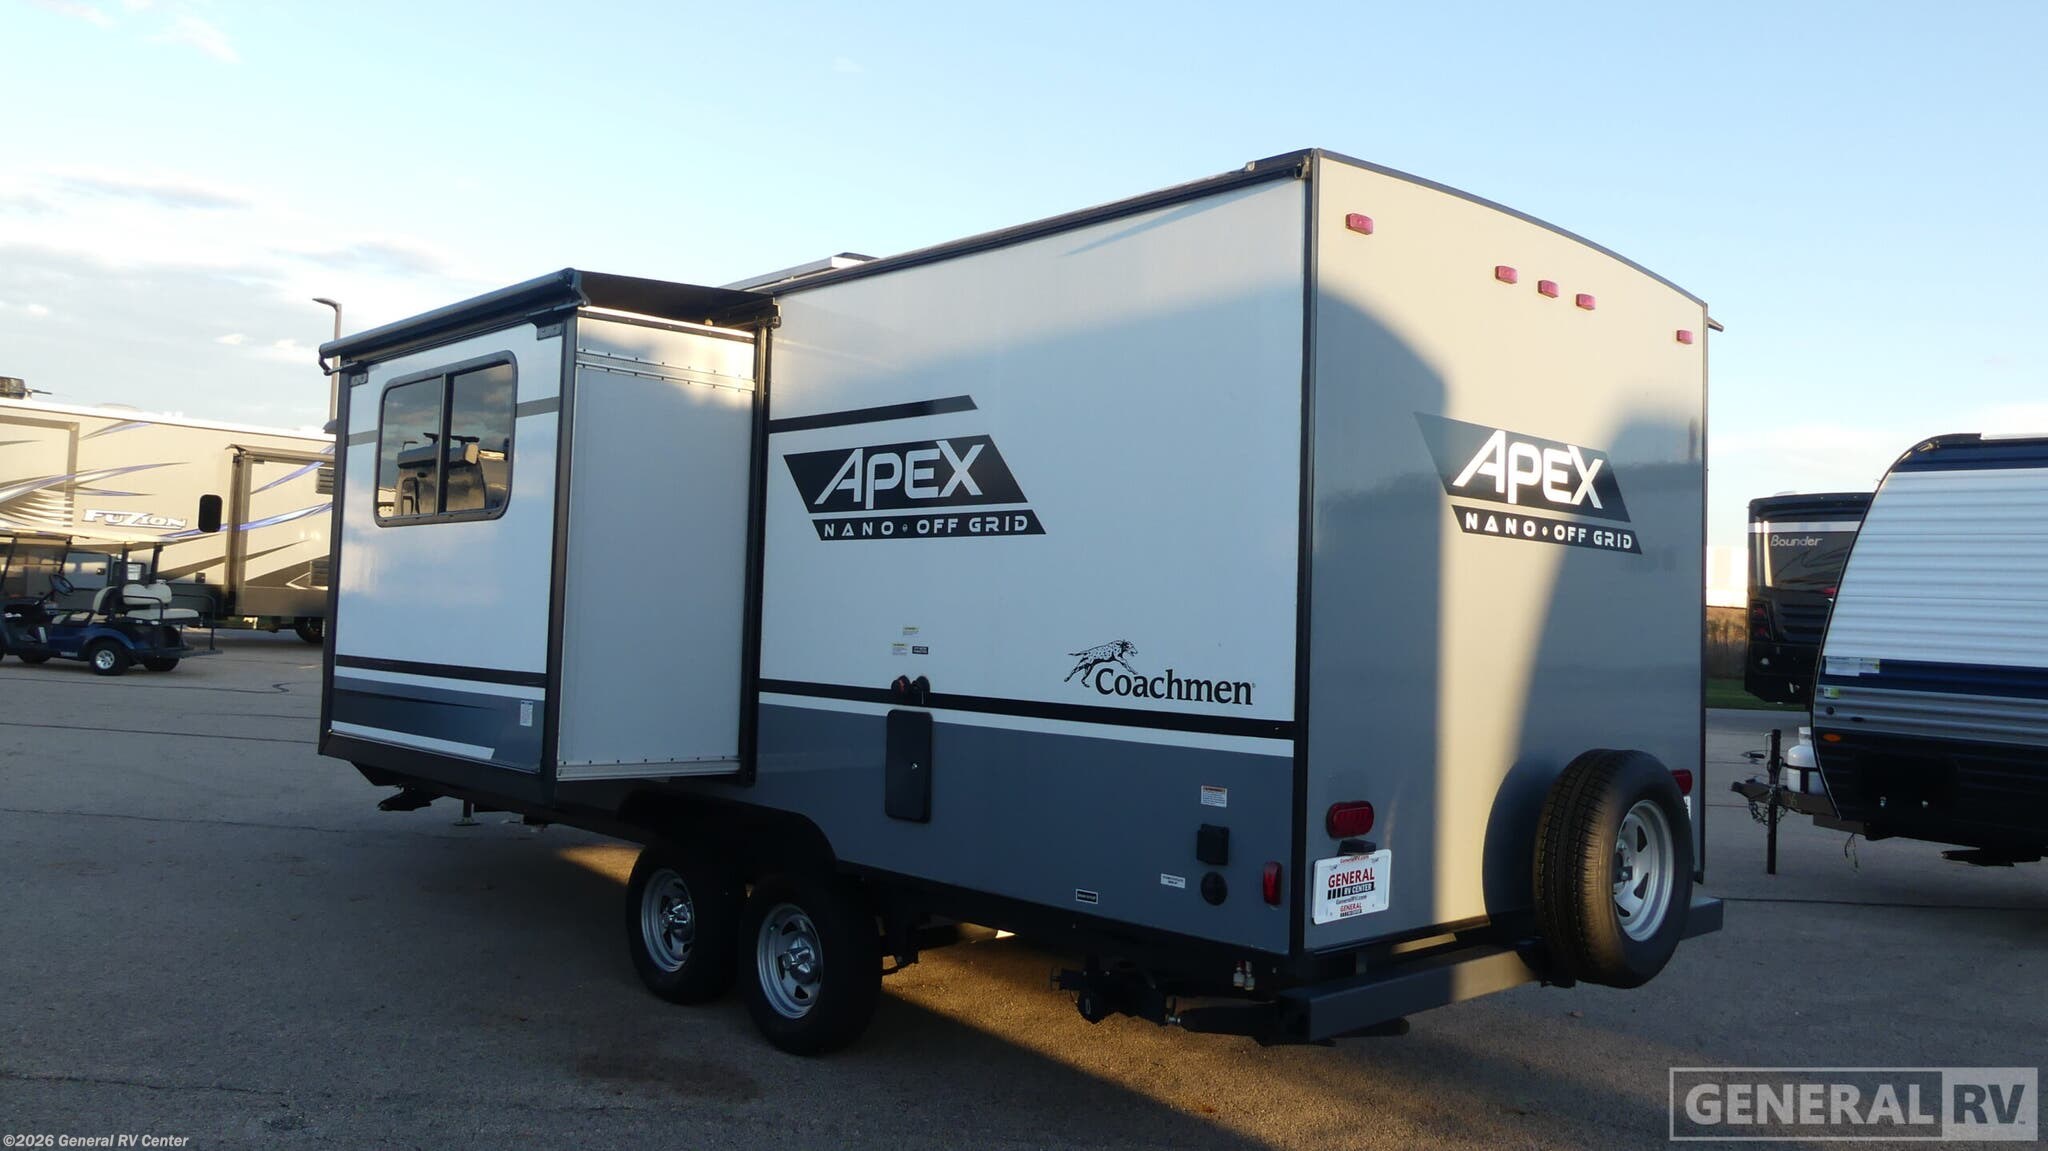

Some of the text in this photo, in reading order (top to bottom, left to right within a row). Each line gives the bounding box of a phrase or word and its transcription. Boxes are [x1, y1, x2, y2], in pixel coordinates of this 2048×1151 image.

[814, 440, 985, 510] APEX
[1452, 429, 1604, 509] APEX
[824, 515, 1028, 537] NANO OFF GRID
[1465, 511, 1632, 549] NANO OFF GRID
[1770, 534, 1823, 547] Bounder
[1095, 667, 1253, 705] Coachmen
[1328, 867, 1375, 888] GENERAL
[1352, 883, 1372, 894] CENTER
